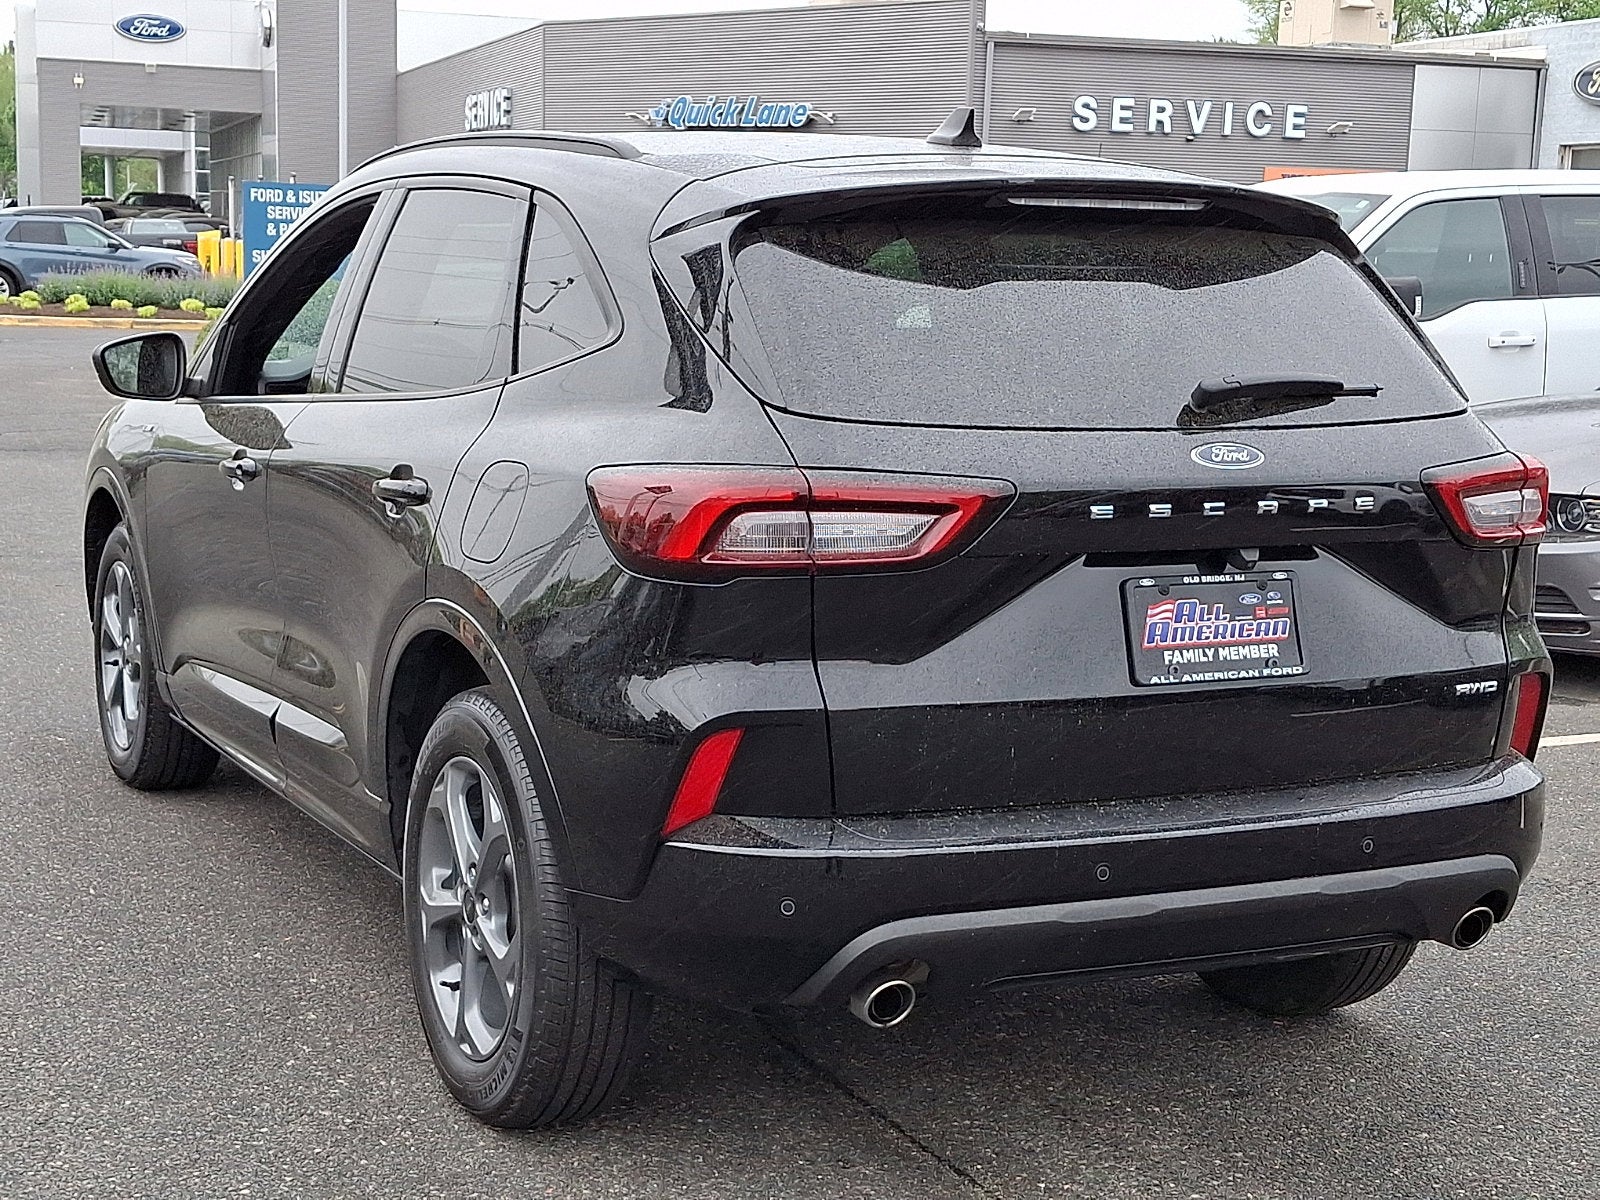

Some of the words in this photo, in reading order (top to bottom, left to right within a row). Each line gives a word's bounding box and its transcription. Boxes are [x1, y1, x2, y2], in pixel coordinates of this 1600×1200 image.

[129, 18, 171, 36] Ford
[464, 87, 512, 131] SERVICE
[669, 95, 741, 129] Quick
[740, 96, 810, 127] Lane
[1072, 95, 1309, 139] SERVICE
[250, 188, 283, 202] FORD
[286, 189, 296, 203] &
[267, 223, 276, 236] &
[1212, 446, 1250, 462] Ford
[1089, 496, 1375, 519] ESCAPE
[1183, 576, 1200, 584] OLD
[1234, 573, 1245, 581] NJ
[1163, 647, 1216, 665] FAMILY
[1218, 643, 1280, 661] MEMBER
[1150, 675, 1179, 684] ALL
[1181, 668, 1260, 682] AMERICAN
[1262, 666, 1303, 677] FORD
[1455, 680, 1498, 696] AWD
